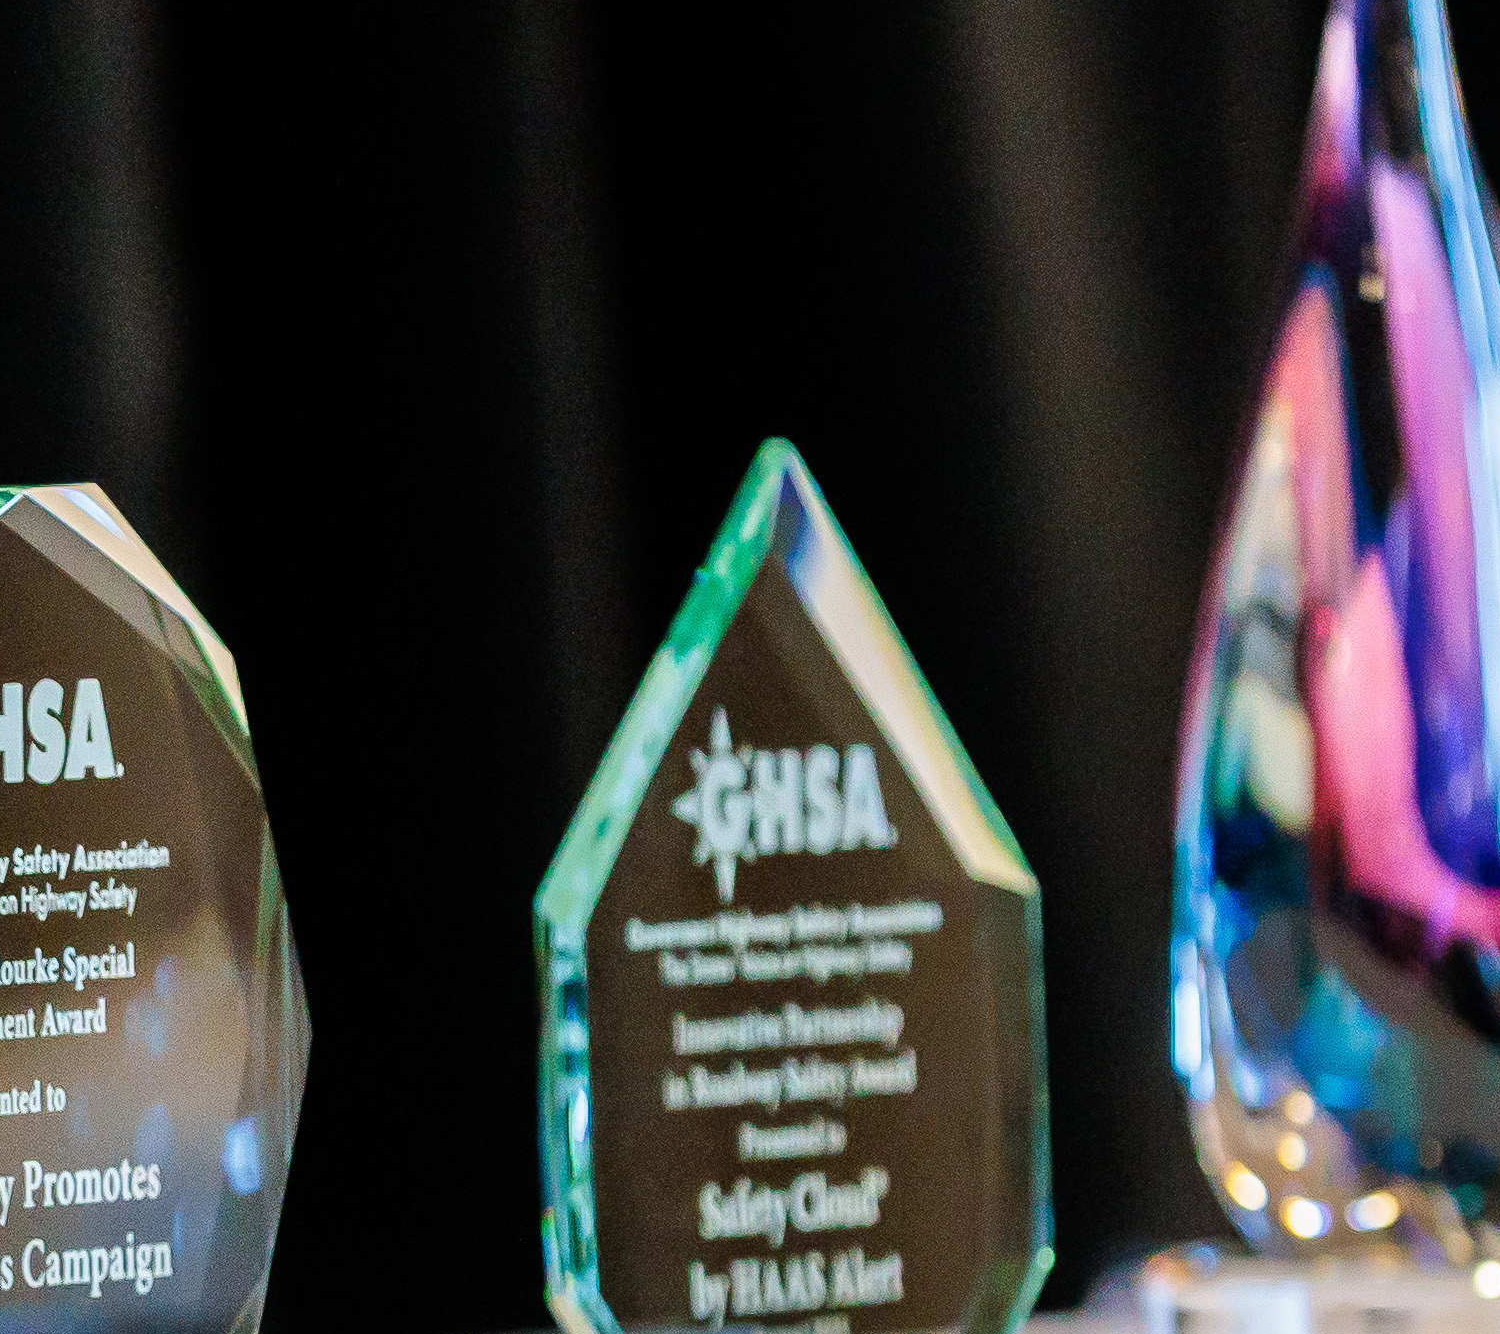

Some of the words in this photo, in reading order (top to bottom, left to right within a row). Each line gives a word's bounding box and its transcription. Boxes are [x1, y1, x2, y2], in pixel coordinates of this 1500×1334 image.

[700, 744, 896, 855] GHSA
[13, 845, 70, 880] Safety
[73, 839, 170, 871] Association
[0, 895, 18, 915] on
[21, 885, 87, 921] Highway
[89, 878, 138, 917] Safety
[62, 941, 136, 992] Special
[40, 996, 107, 1038] Award
[46, 1082, 67, 1113] to
[22, 1158, 162, 1210] Promotes
[699, 1176, 787, 1249] Safety
[21, 1231, 173, 1298] Campaign
[689, 1259, 728, 1332] by
[730, 1249, 827, 1317] HAAS
[828, 1246, 904, 1308] Alert
